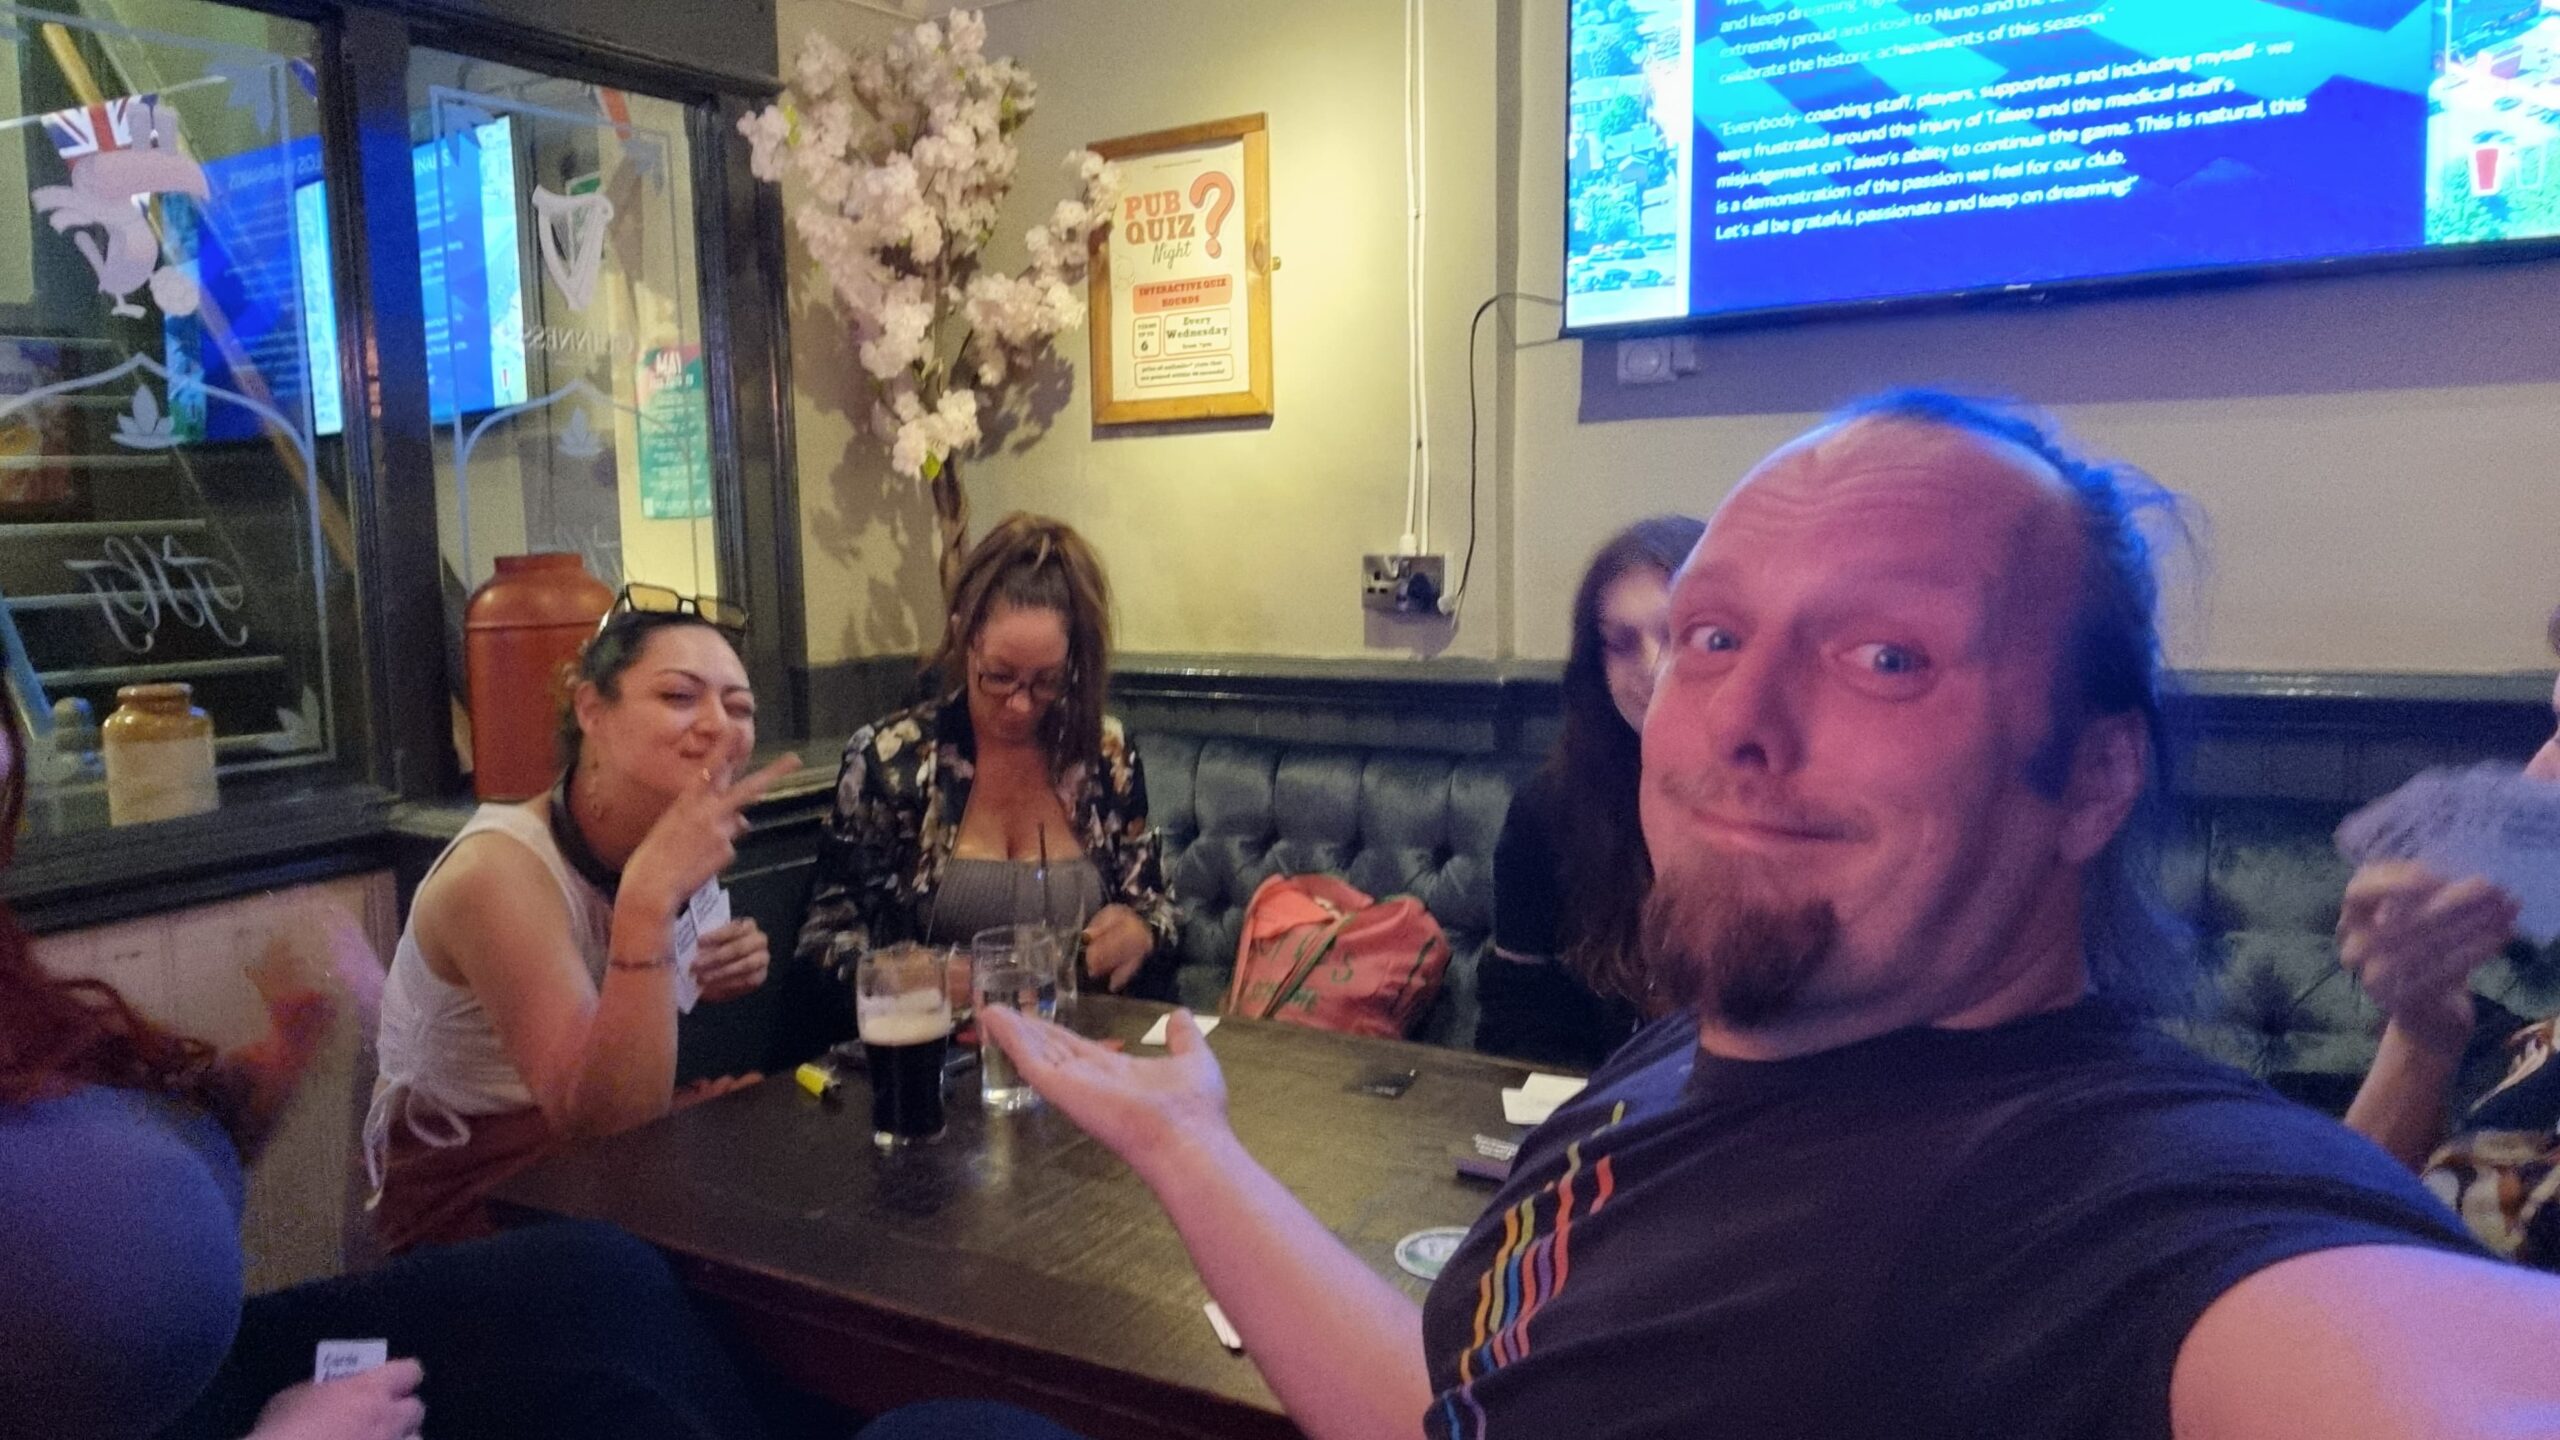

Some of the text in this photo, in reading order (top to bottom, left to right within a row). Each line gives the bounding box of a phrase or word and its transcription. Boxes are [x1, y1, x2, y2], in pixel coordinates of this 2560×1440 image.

[1720, 13, 1748, 33] and
[1750, 11, 1785, 28] keep
[1720, 35, 1790, 58] extremely
[1792, 28, 1837, 49] proud
[1840, 22, 1869, 37] and
[1872, 15, 1911, 31] close
[1913, 12, 1933, 25] to
[1935, 4, 1979, 22] Nuno
[1981, 0, 2013, 15] and
[1719, 63, 1787, 85] celebrate
[1789, 58, 1815, 74] the
[1816, 53, 1870, 70] historic
[1876, 31, 1985, 58] achievements
[1987, 24, 2005, 42] of
[2008, 21, 2041, 39] this
[1804, 102, 1872, 124] coaching
[1979, 72, 2072, 99] supporters
[2074, 64, 2109, 85] and
[2111, 55, 2192, 80] including
[1716, 148, 1752, 163] were
[1754, 132, 1830, 157] frustrated
[1832, 124, 1887, 146] around
[1889, 121, 1917, 138] the
[1918, 117, 1963, 135] injury
[1965, 111, 1983, 127] of
[1985, 107, 2035, 124] Taiwo
[2035, 98, 2070, 119] and
[2072, 96, 2103, 114] the
[2105, 83, 2175, 109] medical
[1716, 162, 1819, 189] misjudgement
[1821, 161, 1841, 175] on
[1901, 144, 1950, 165] ability
[1952, 143, 1971, 157] to
[1972, 133, 2047, 155] continue
[2048, 128, 2079, 145] the
[2135, 113, 2174, 133] This
[2176, 111, 2193, 128] is
[2269, 96, 2307, 116] this
[1716, 200, 1729, 214] is
[1730, 200, 1740, 213] a
[1742, 184, 1851, 212] demonstration
[1853, 179, 1872, 197] of
[1872, 177, 1900, 195] the
[1902, 170, 1964, 194] passion
[1966, 168, 1991, 183] we
[1993, 161, 2024, 180] feel
[2026, 158, 2051, 176] for
[2053, 156, 2084, 172] our
[1123, 190, 1182, 221] PUB
[1715, 222, 1750, 241] Let's
[1751, 219, 1769, 236] all
[1770, 218, 1790, 234] be
[1856, 200, 1943, 227] passionate
[1944, 193, 1976, 213] and
[1978, 192, 2019, 210] keep
[2020, 189, 2044, 204] on
[1124, 213, 1196, 246] QUIZ
[1152, 239, 1192, 270] Night
[1139, 278, 1227, 296] INTERACTIVE QUIZ
[1162, 295, 1200, 307] ROUNDS
[1166, 326, 1228, 339] Wednesday
[1183, 317, 1211, 326] Every
[1141, 341, 1148, 351] 6
